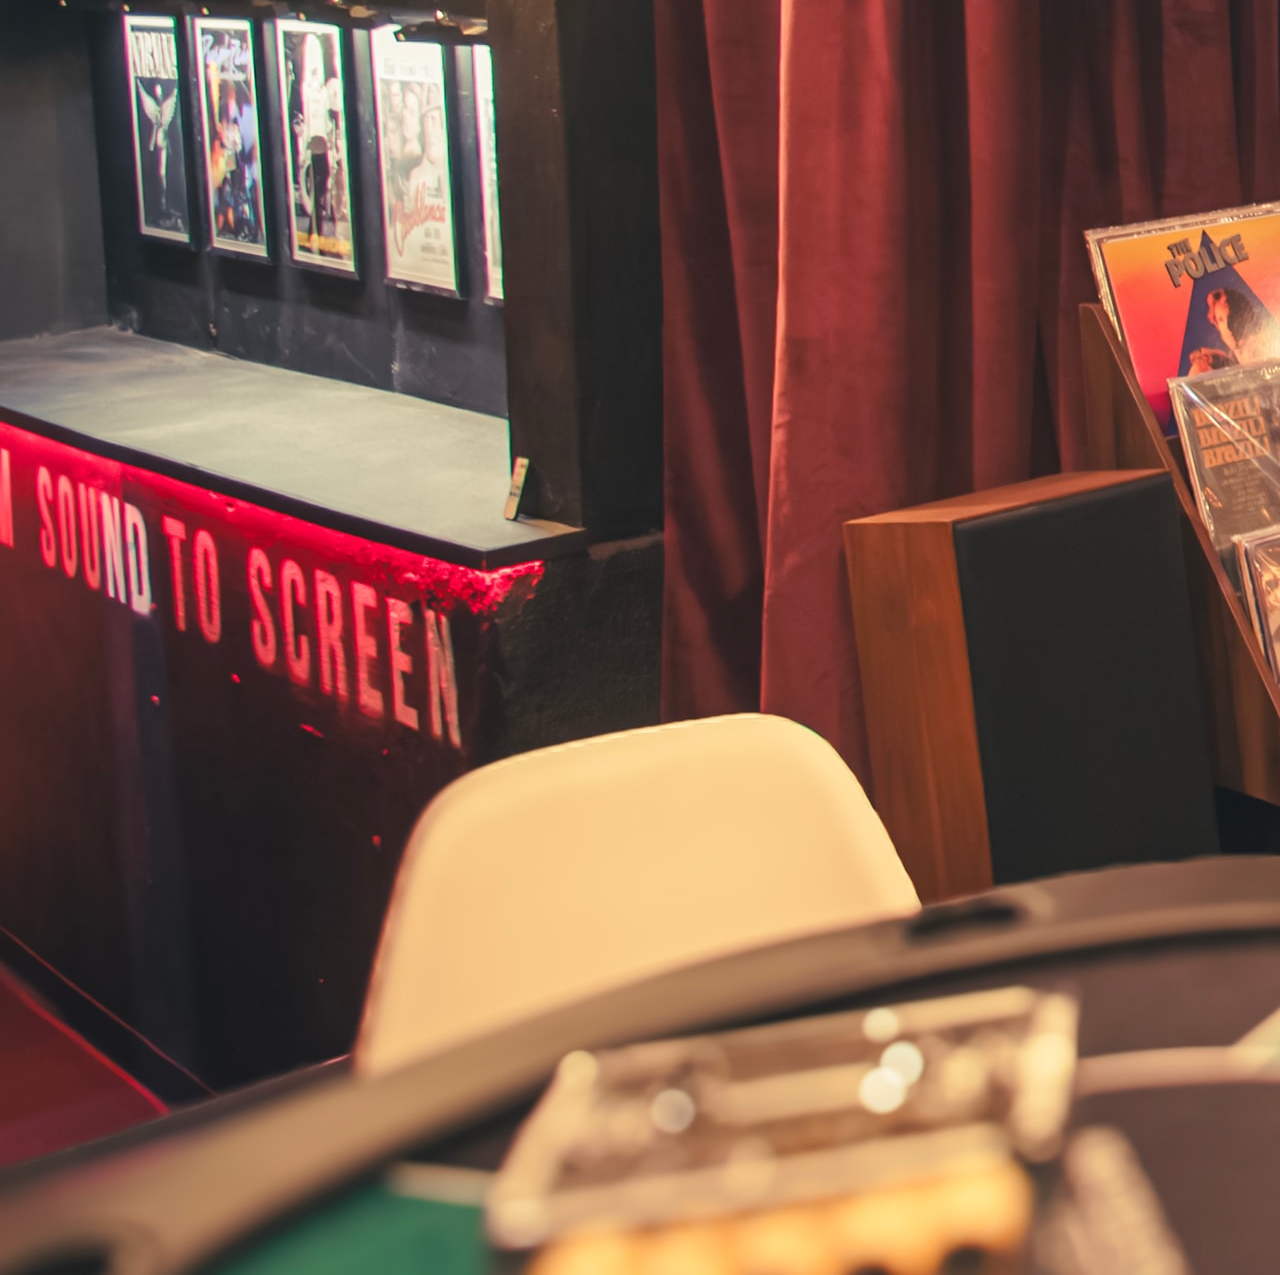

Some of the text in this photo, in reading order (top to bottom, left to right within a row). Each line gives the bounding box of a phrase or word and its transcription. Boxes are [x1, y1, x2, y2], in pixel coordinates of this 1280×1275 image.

[1165, 233, 1249, 288] POLICE
[1167, 238, 1192, 259] THE
[36, 465, 152, 616] SOUND
[161, 514, 221, 644] TO
[247, 546, 462, 749] SCREEN
